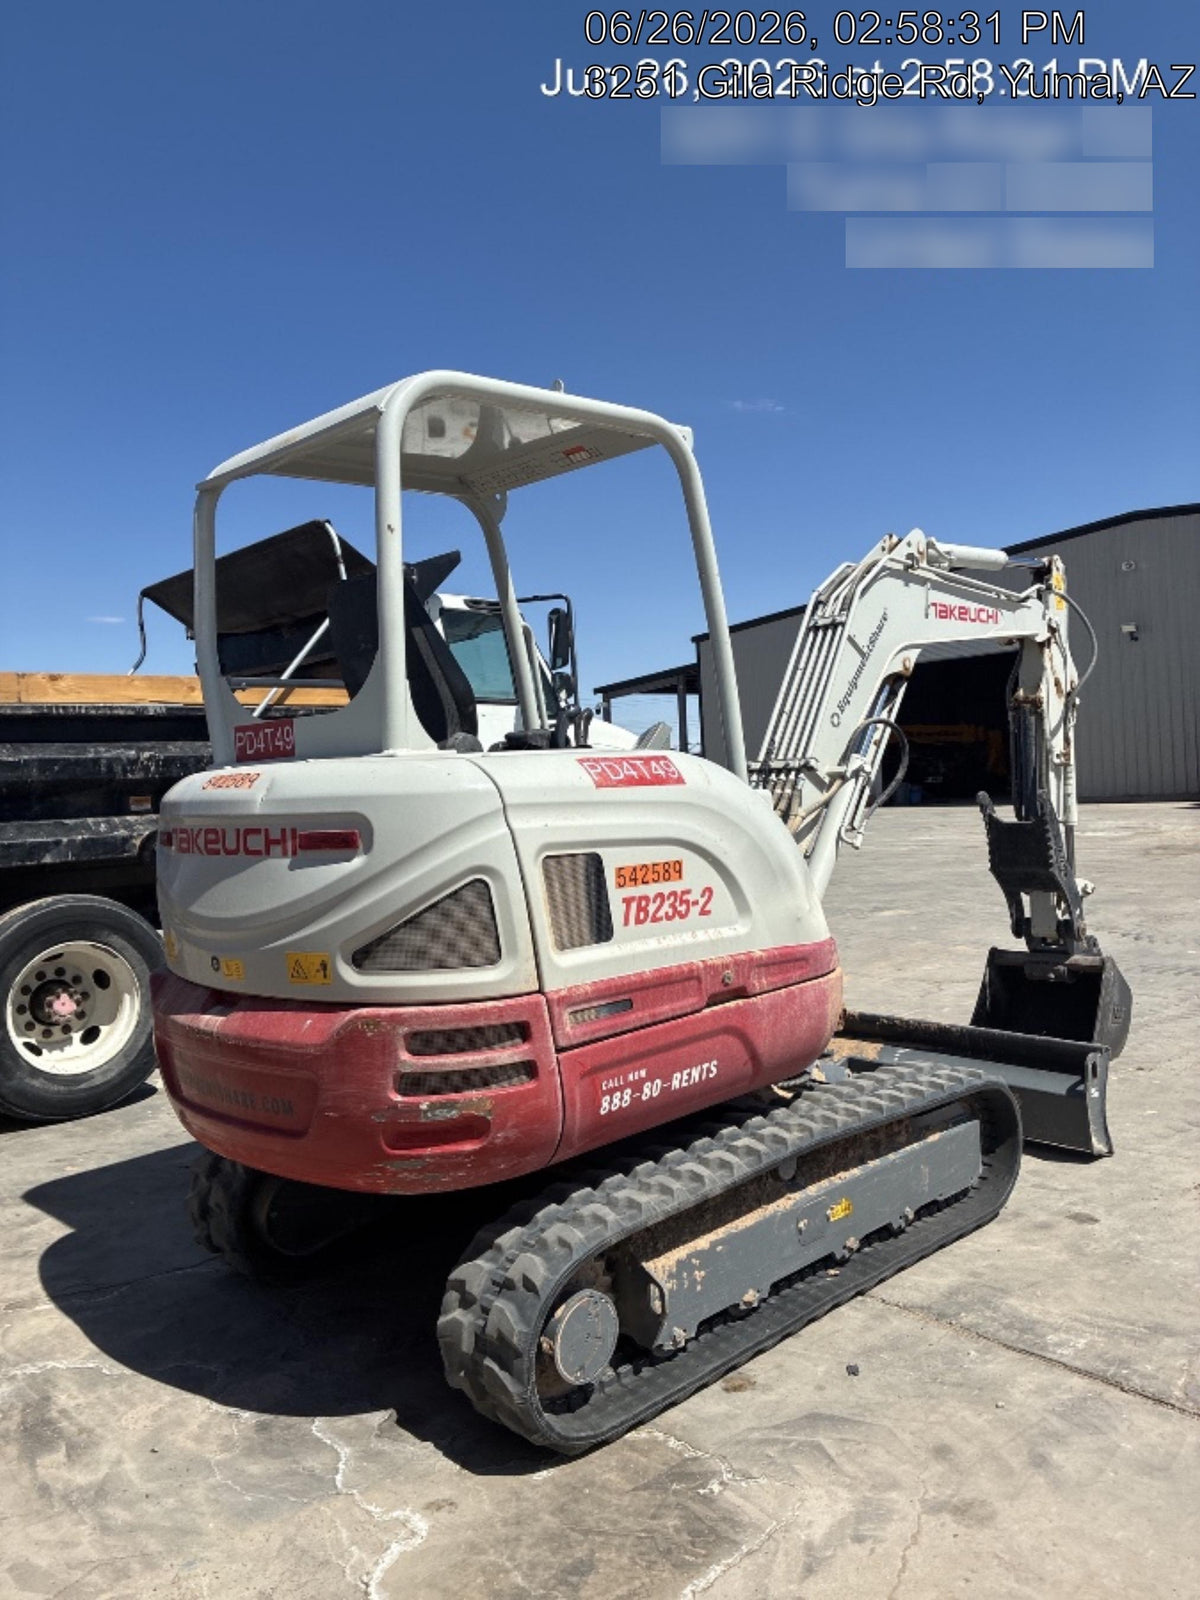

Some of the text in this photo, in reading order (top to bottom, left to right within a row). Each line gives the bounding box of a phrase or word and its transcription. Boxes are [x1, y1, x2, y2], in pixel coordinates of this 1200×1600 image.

[235, 726, 294, 755] PD4T49
[582, 758, 680, 781] PD4T49
[616, 860, 683, 888] 542589
[622, 886, 714, 927] TB235-2
[600, 1060, 718, 1115] 888-80-RENTS
[602, 1075, 624, 1090] CALL
